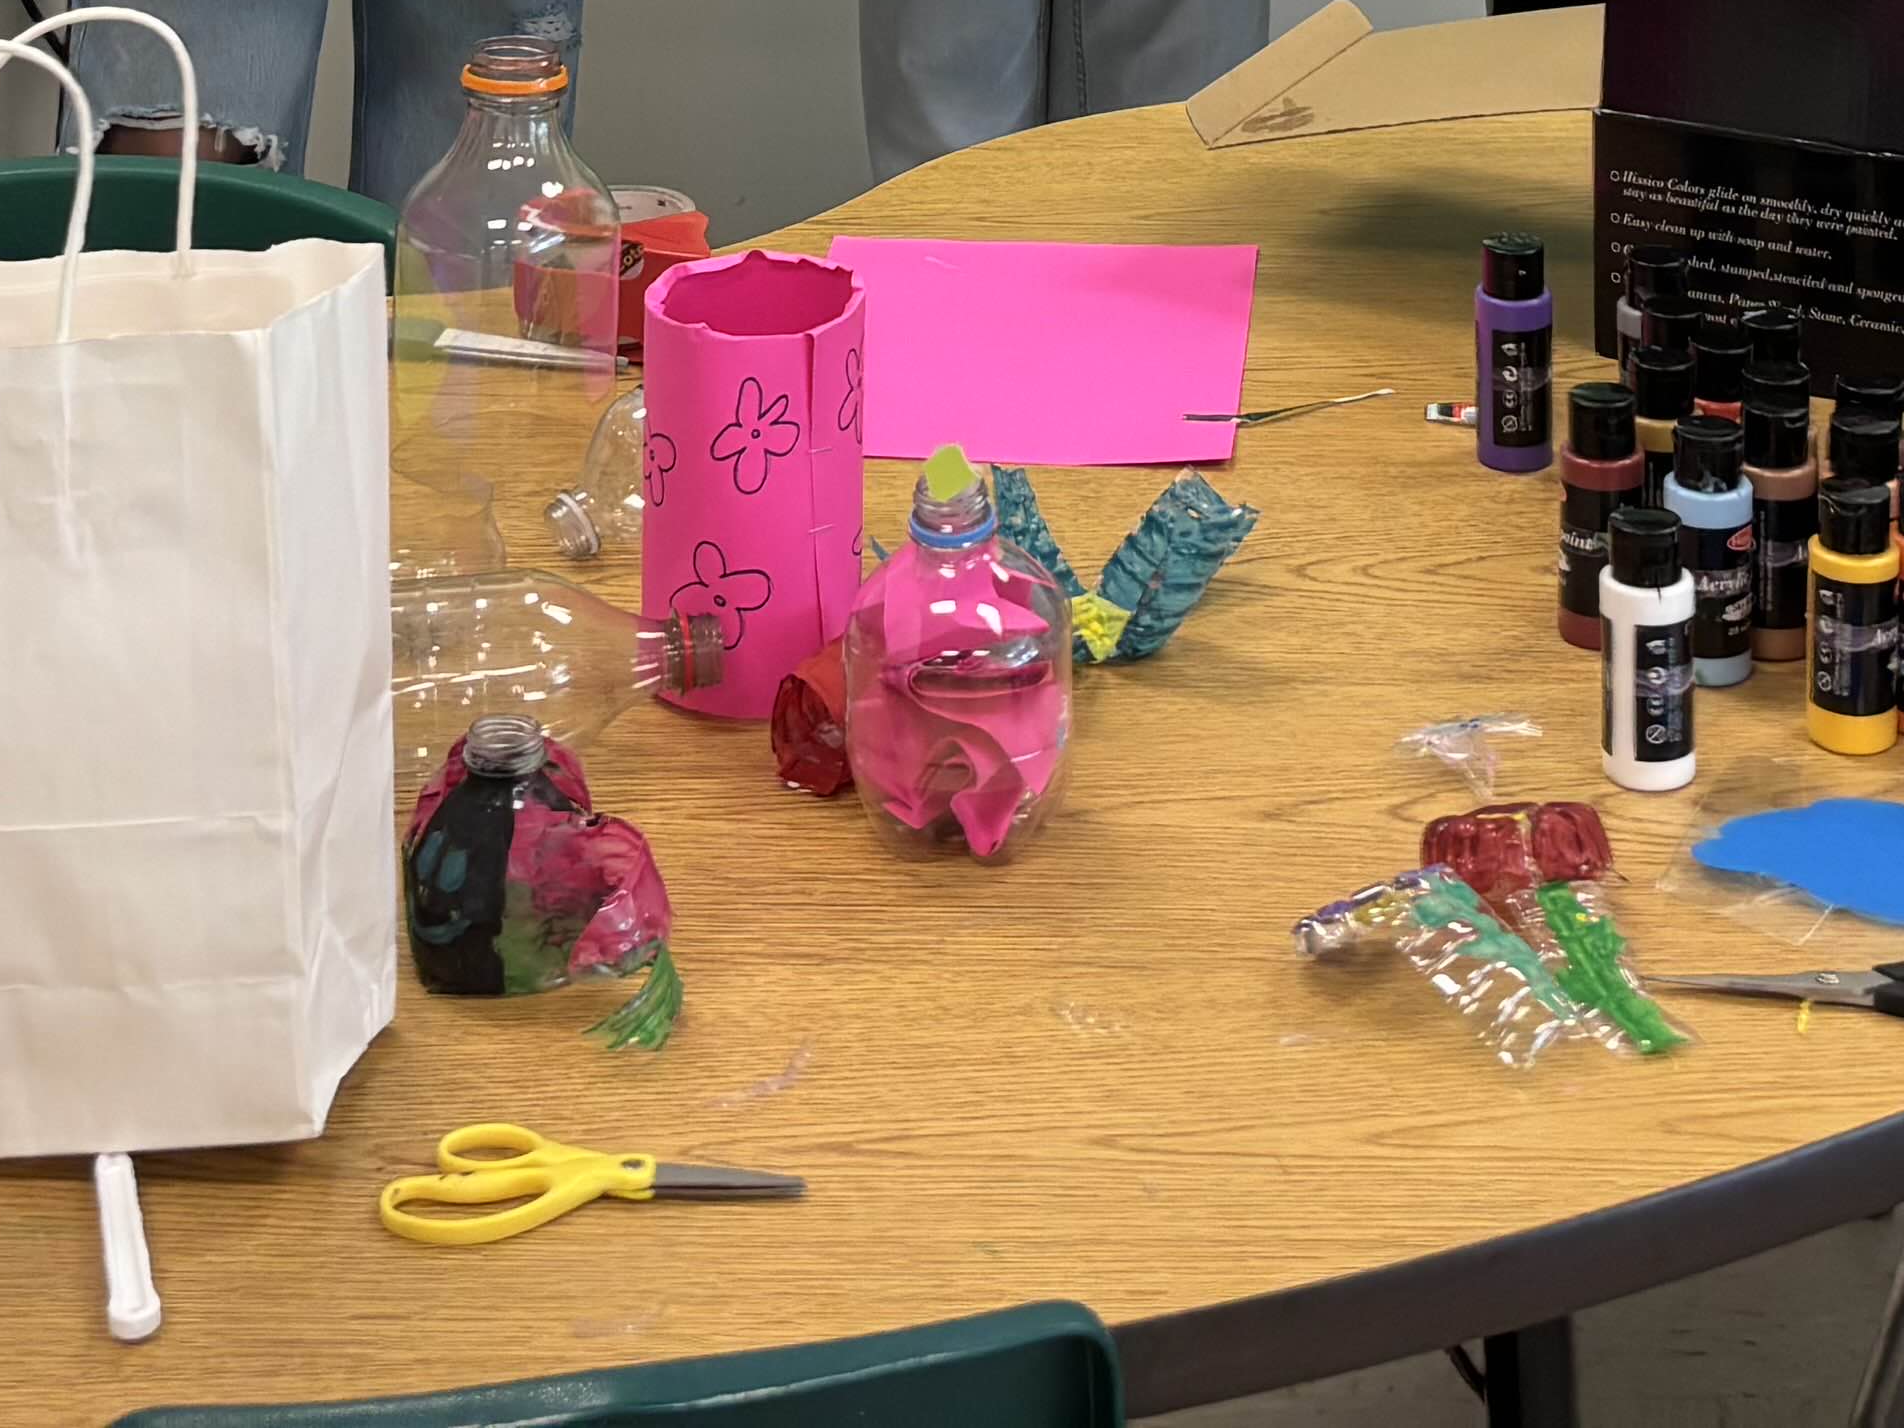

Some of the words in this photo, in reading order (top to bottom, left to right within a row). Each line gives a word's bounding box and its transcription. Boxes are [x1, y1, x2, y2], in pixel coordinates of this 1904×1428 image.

[1623, 187, 1645, 202] stay
[1649, 192, 1663, 201] as
[1665, 190, 1720, 212] beautiful
[1722, 204, 1736, 214] as
[1738, 204, 1760, 218] the
[1760, 208, 1784, 225] day
[1786, 211, 1813, 230] they
[1816, 219, 1844, 232] were
[1667, 178, 1706, 195] Colors
[1708, 186, 1740, 203] glide
[1741, 194, 1757, 205] on
[1820, 202, 1843, 221] dry
[1845, 209, 1892, 228] quickly
[1623, 213, 1653, 231] Easy
[1655, 219, 1687, 236] clean
[1689, 228, 1706, 241] up
[1708, 228, 1734, 244] with
[1736, 237, 1766, 251] soap
[1768, 240, 1793, 254] and
[1827, 280, 1854, 295] and
